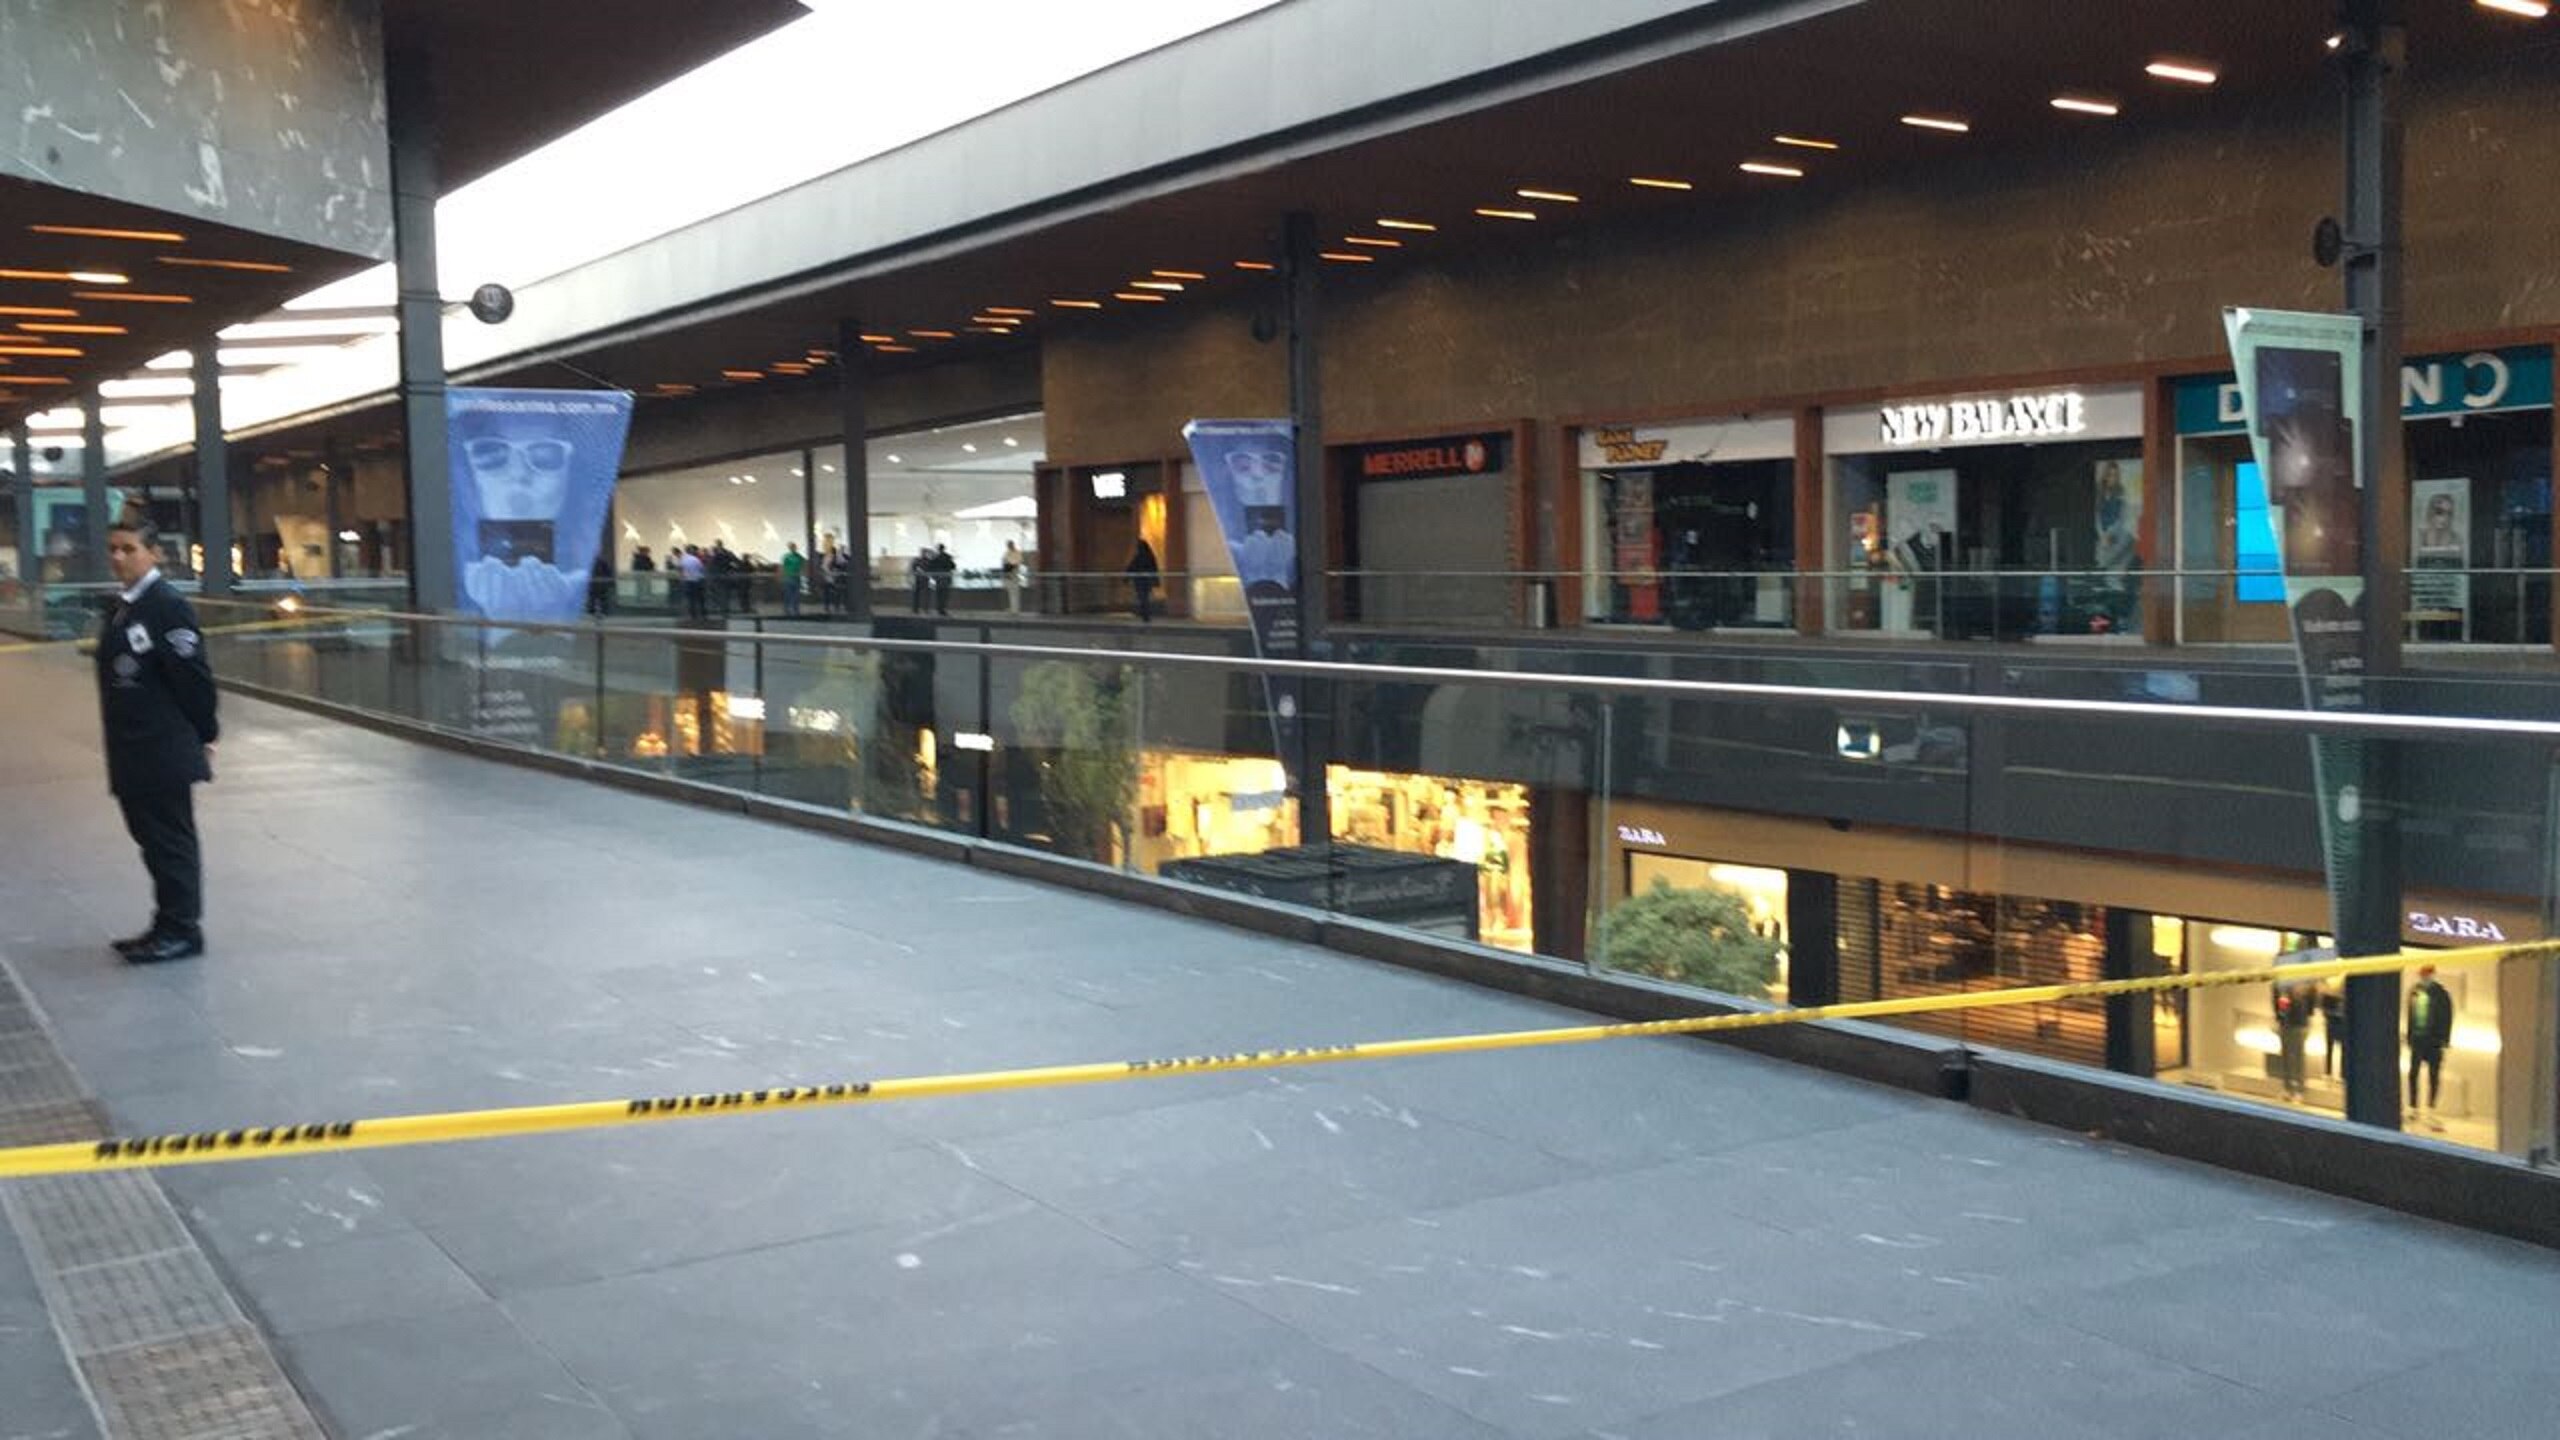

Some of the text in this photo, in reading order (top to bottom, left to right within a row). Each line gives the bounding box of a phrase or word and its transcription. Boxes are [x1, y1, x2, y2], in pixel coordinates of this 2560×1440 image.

[1880, 392, 2087, 445] NEW BALANCE
[1363, 448, 1462, 475] MERRELL
[1617, 825, 1667, 846] ZARA
[2407, 911, 2506, 941] ZARA
